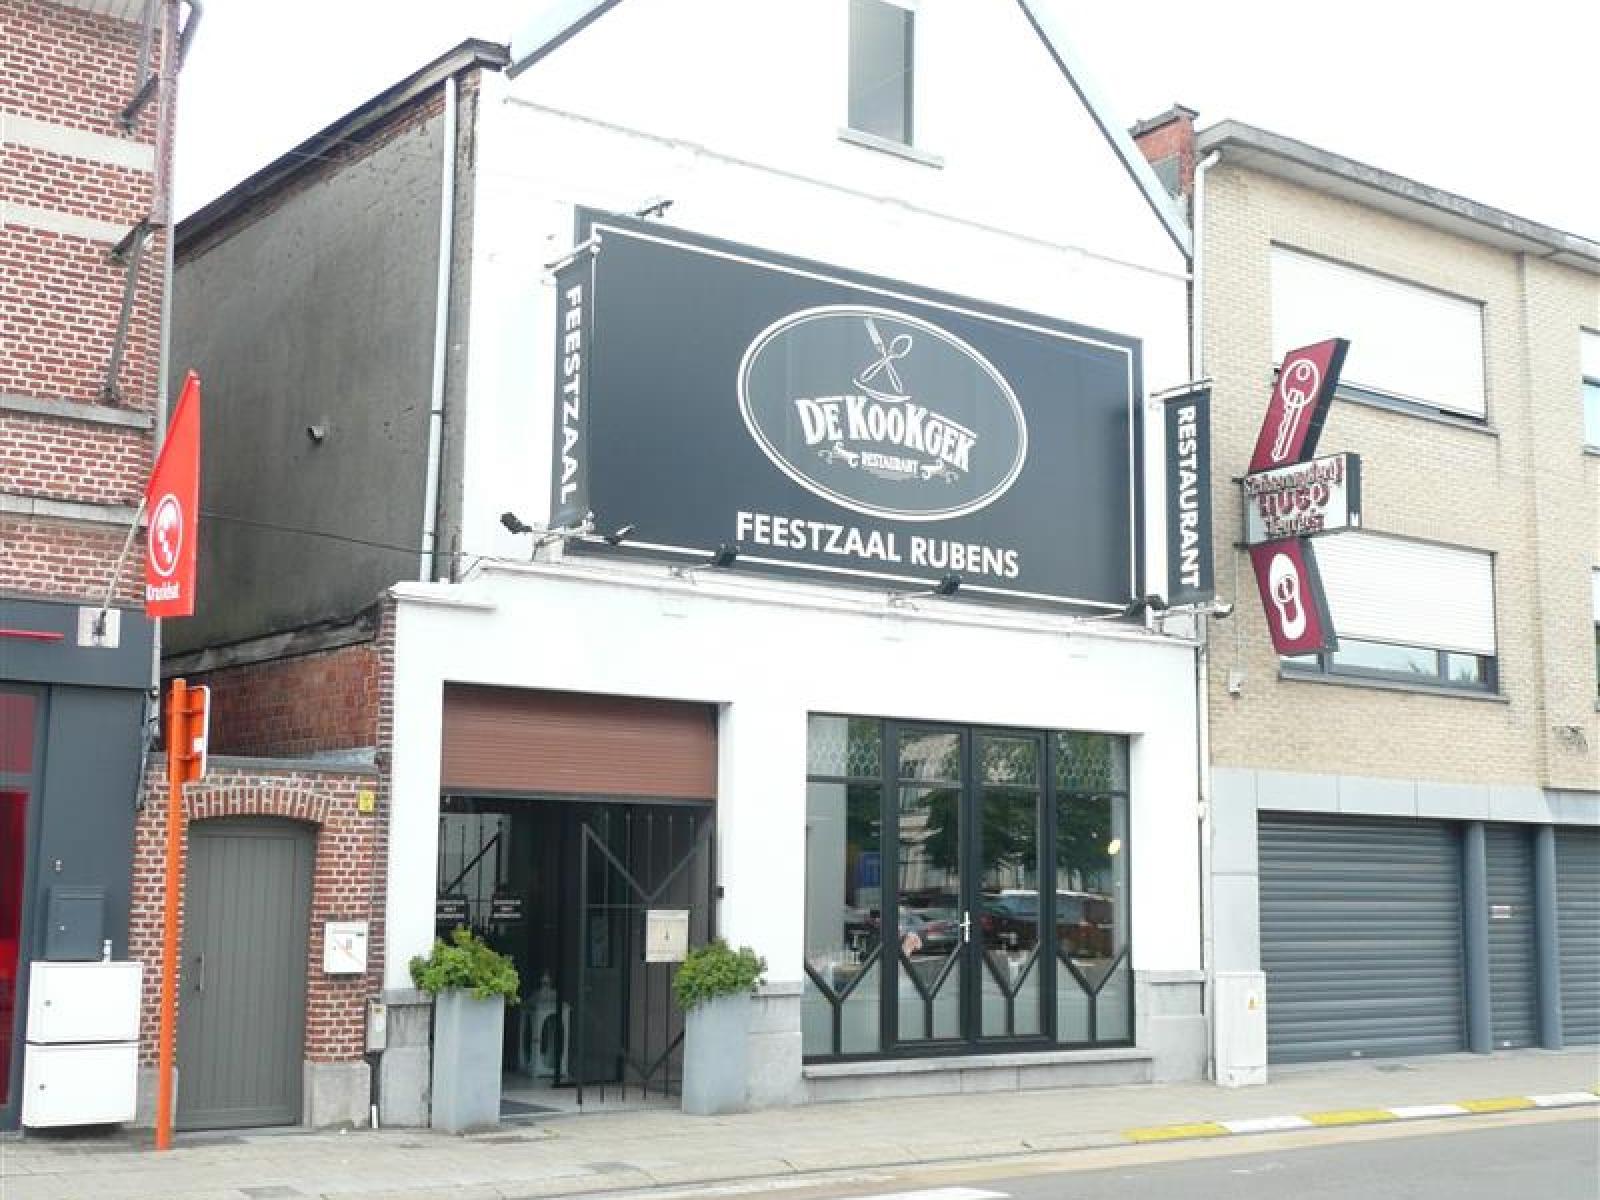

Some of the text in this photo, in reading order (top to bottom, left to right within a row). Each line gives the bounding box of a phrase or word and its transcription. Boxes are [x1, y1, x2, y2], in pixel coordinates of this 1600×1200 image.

[560, 284, 582, 505] FEESTZAAL
[737, 512, 1019, 578] FEESTZAAL RUBENS
[1177, 405, 1199, 588] RESTAURANT
